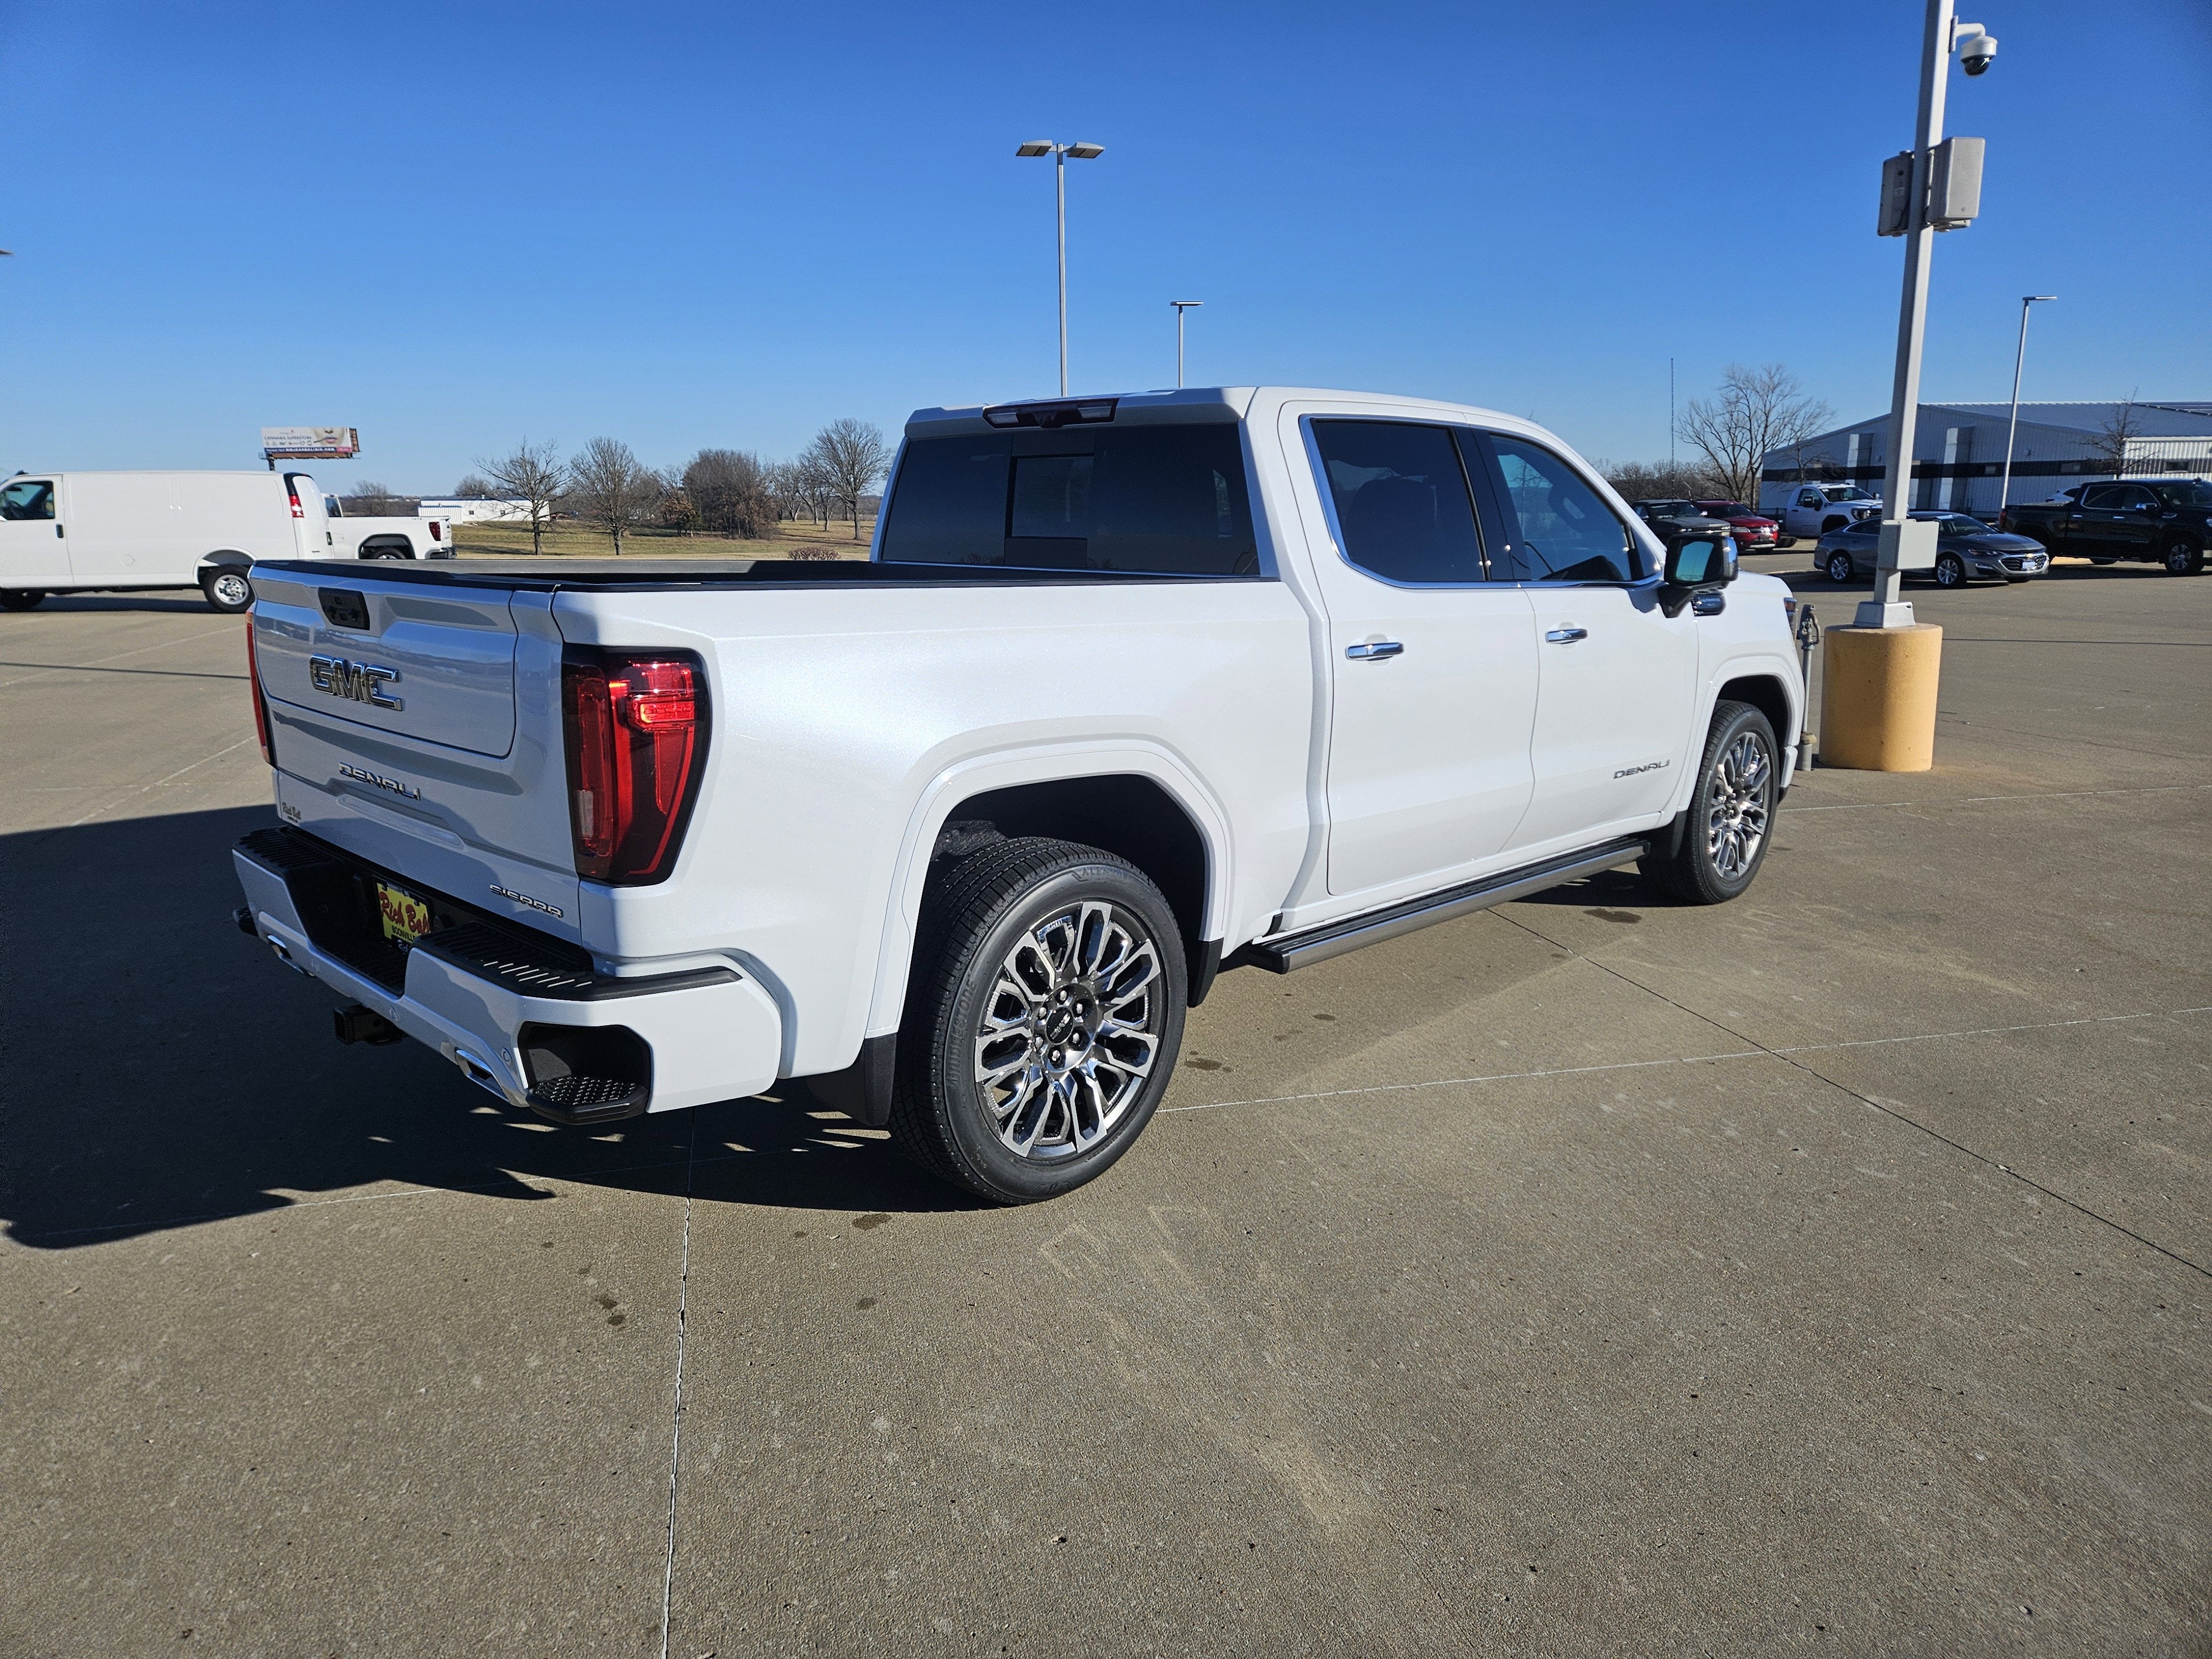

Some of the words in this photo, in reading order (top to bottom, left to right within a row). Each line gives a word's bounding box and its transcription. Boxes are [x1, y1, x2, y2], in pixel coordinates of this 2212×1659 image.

[309, 653, 403, 711] GMC
[338, 761, 421, 802] DENALI
[1613, 759, 1670, 779] DENALI
[379, 891, 405, 927] Rich
[489, 884, 564, 918] SIERRA
[945, 978, 977, 1087] BRIDGESTONE
[1050, 1013, 1071, 1039] GMC
